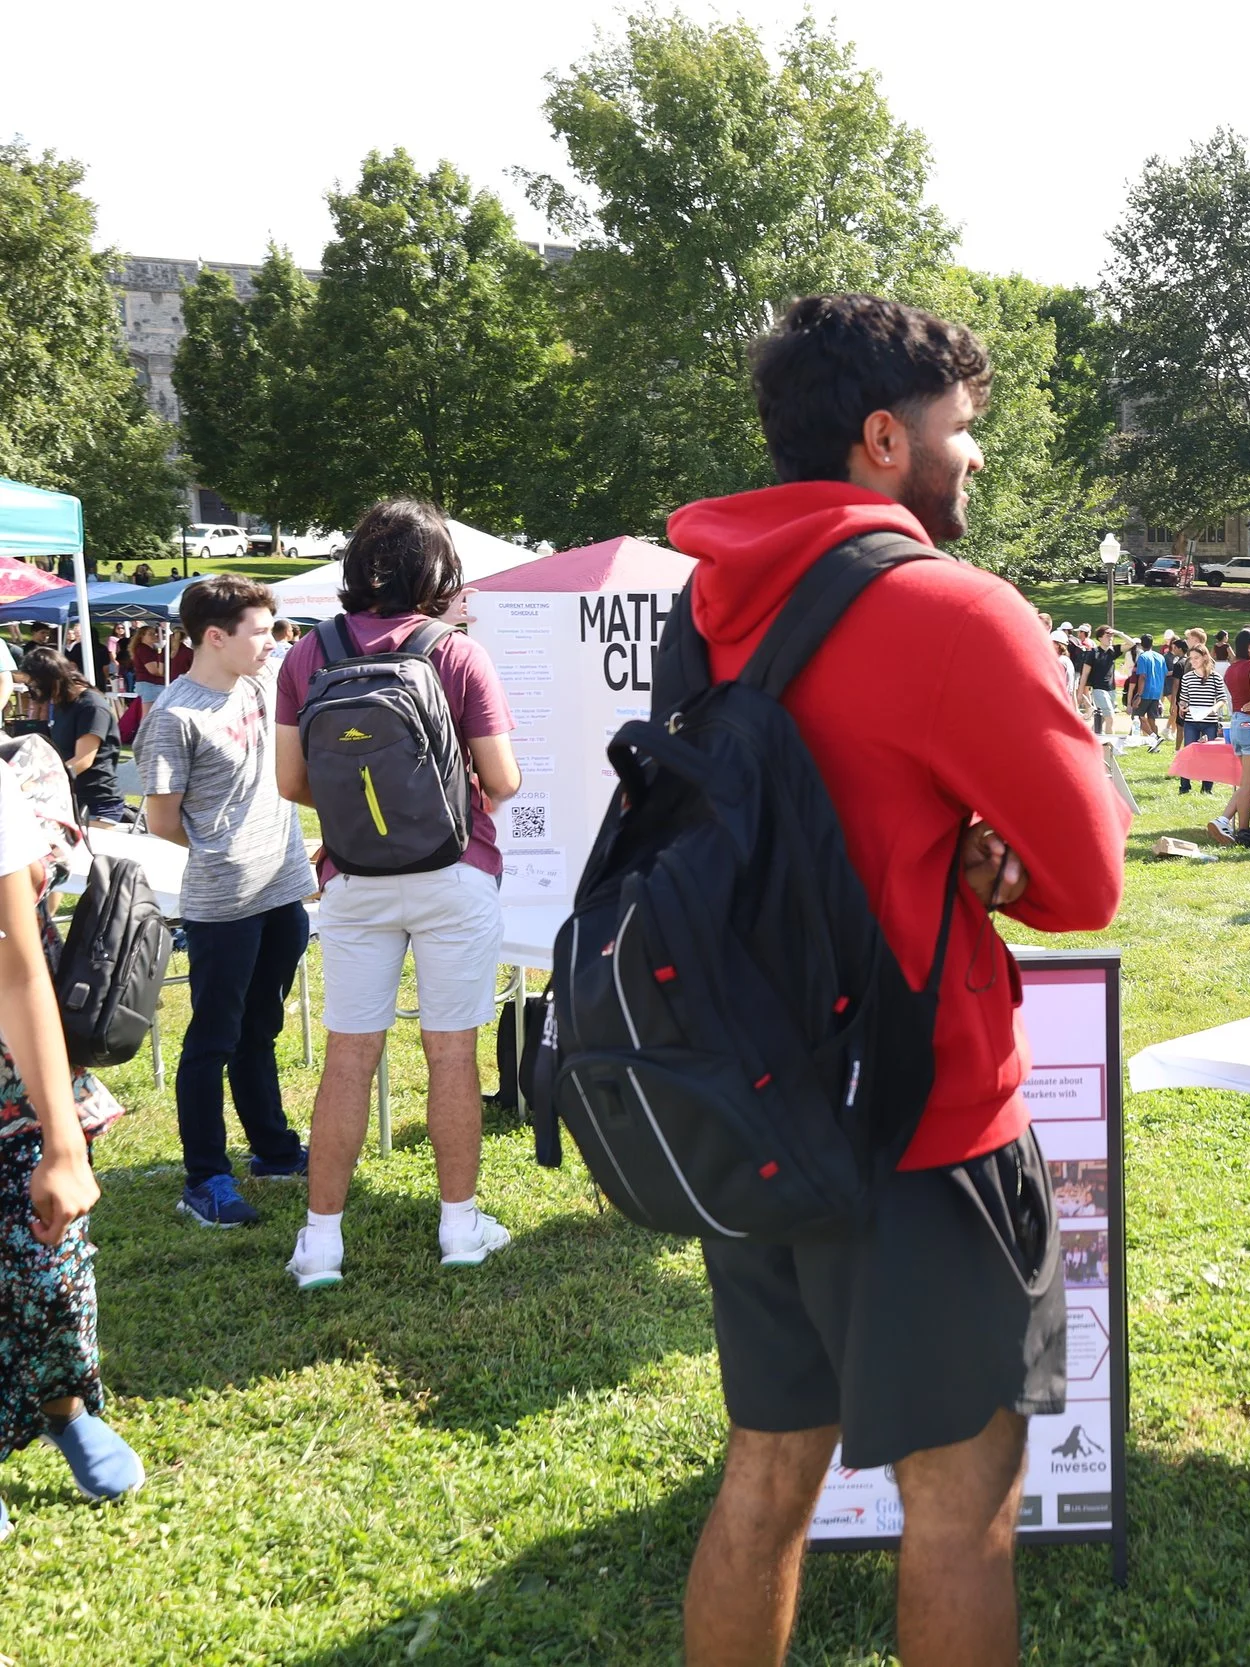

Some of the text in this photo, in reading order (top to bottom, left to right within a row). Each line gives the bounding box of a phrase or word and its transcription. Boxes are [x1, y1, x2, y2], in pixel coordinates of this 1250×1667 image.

[580, 593, 679, 643] MATH
[603, 642, 657, 692] CL
[1022, 1077, 1083, 1086] ssionate about
[1023, 1090, 1077, 1099] Markets with
[1051, 1461, 1107, 1473] Invesco
